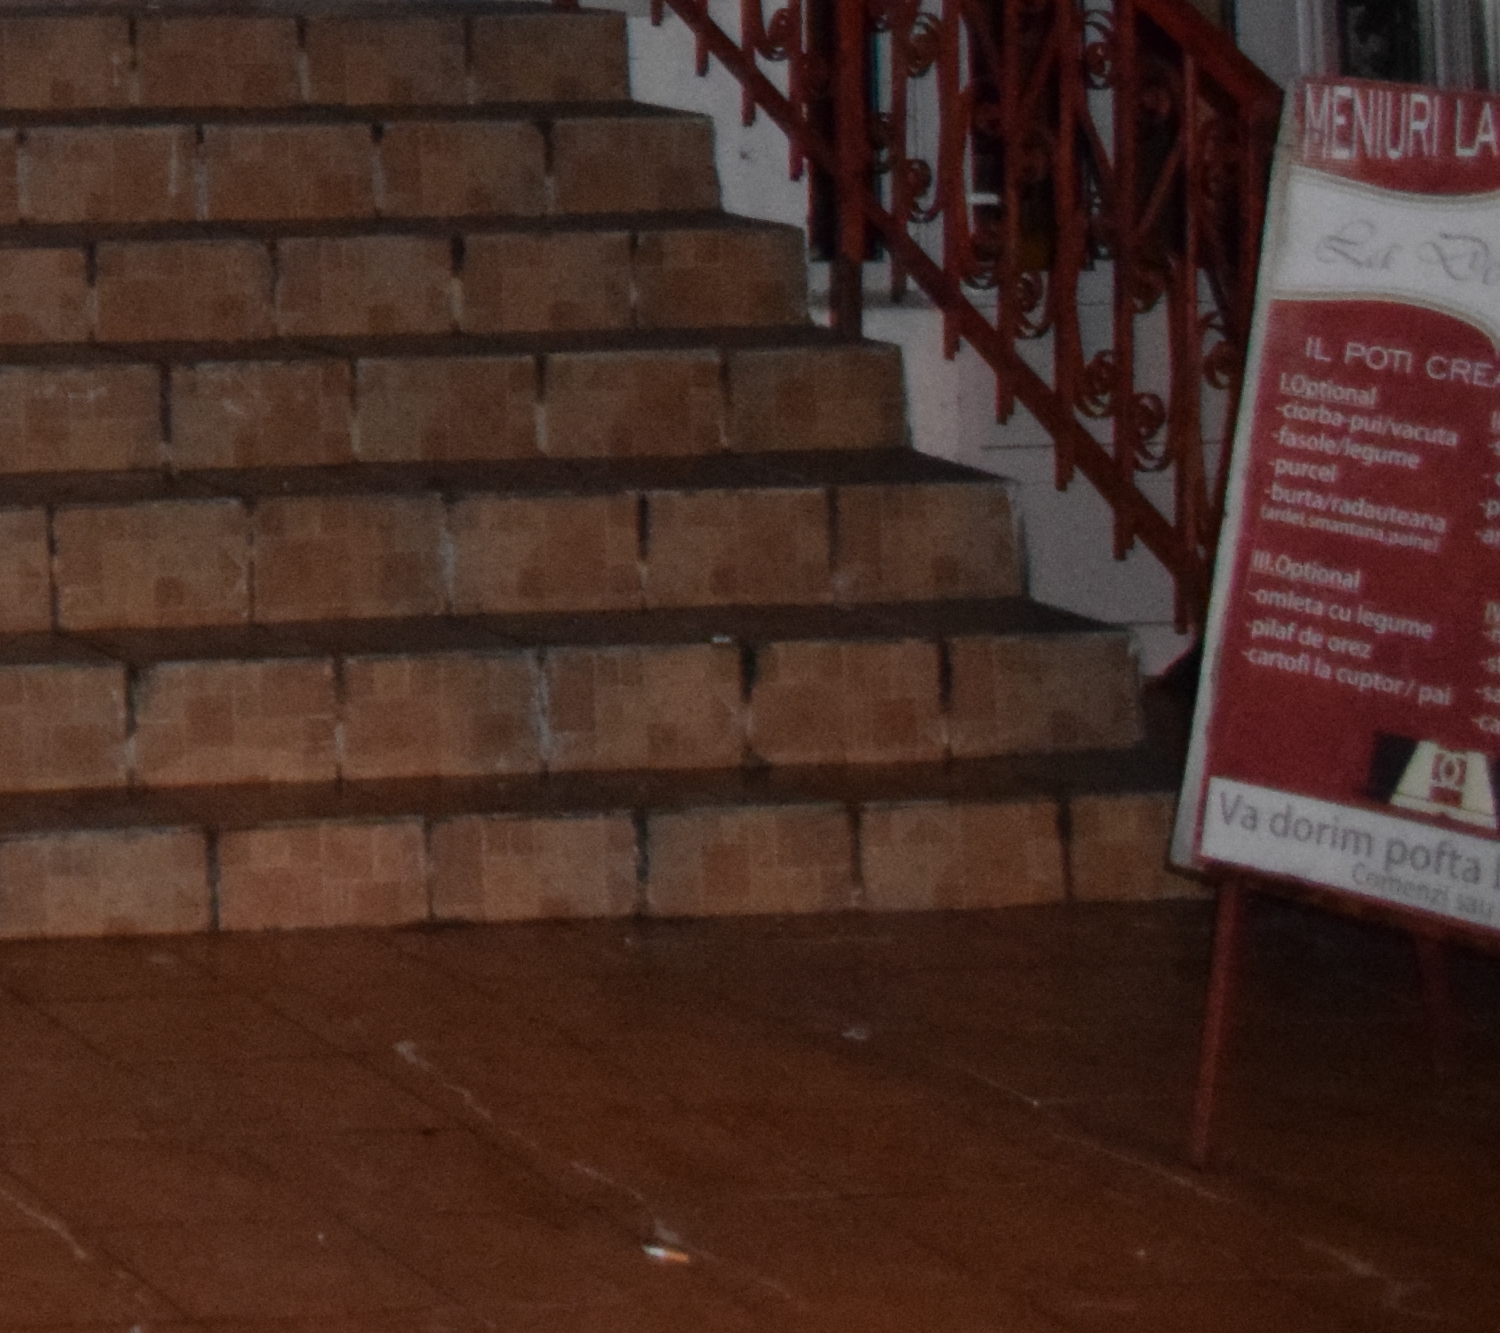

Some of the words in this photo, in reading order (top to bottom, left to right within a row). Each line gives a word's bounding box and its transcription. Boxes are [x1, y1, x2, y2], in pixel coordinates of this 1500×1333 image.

[1304, 83, 1441, 161] MENIURI
[1343, 341, 1414, 375] POTI
[1328, 603, 1353, 623] cu
[1355, 603, 1436, 641] legume
[1297, 625, 1324, 648] de
[1326, 636, 1374, 660] orez
[1313, 657, 1332, 680] la
[1335, 666, 1404, 695] cuptor
[1218, 791, 1260, 831] Va
[1268, 804, 1376, 858] dorim
[1382, 837, 1482, 885] pofta
